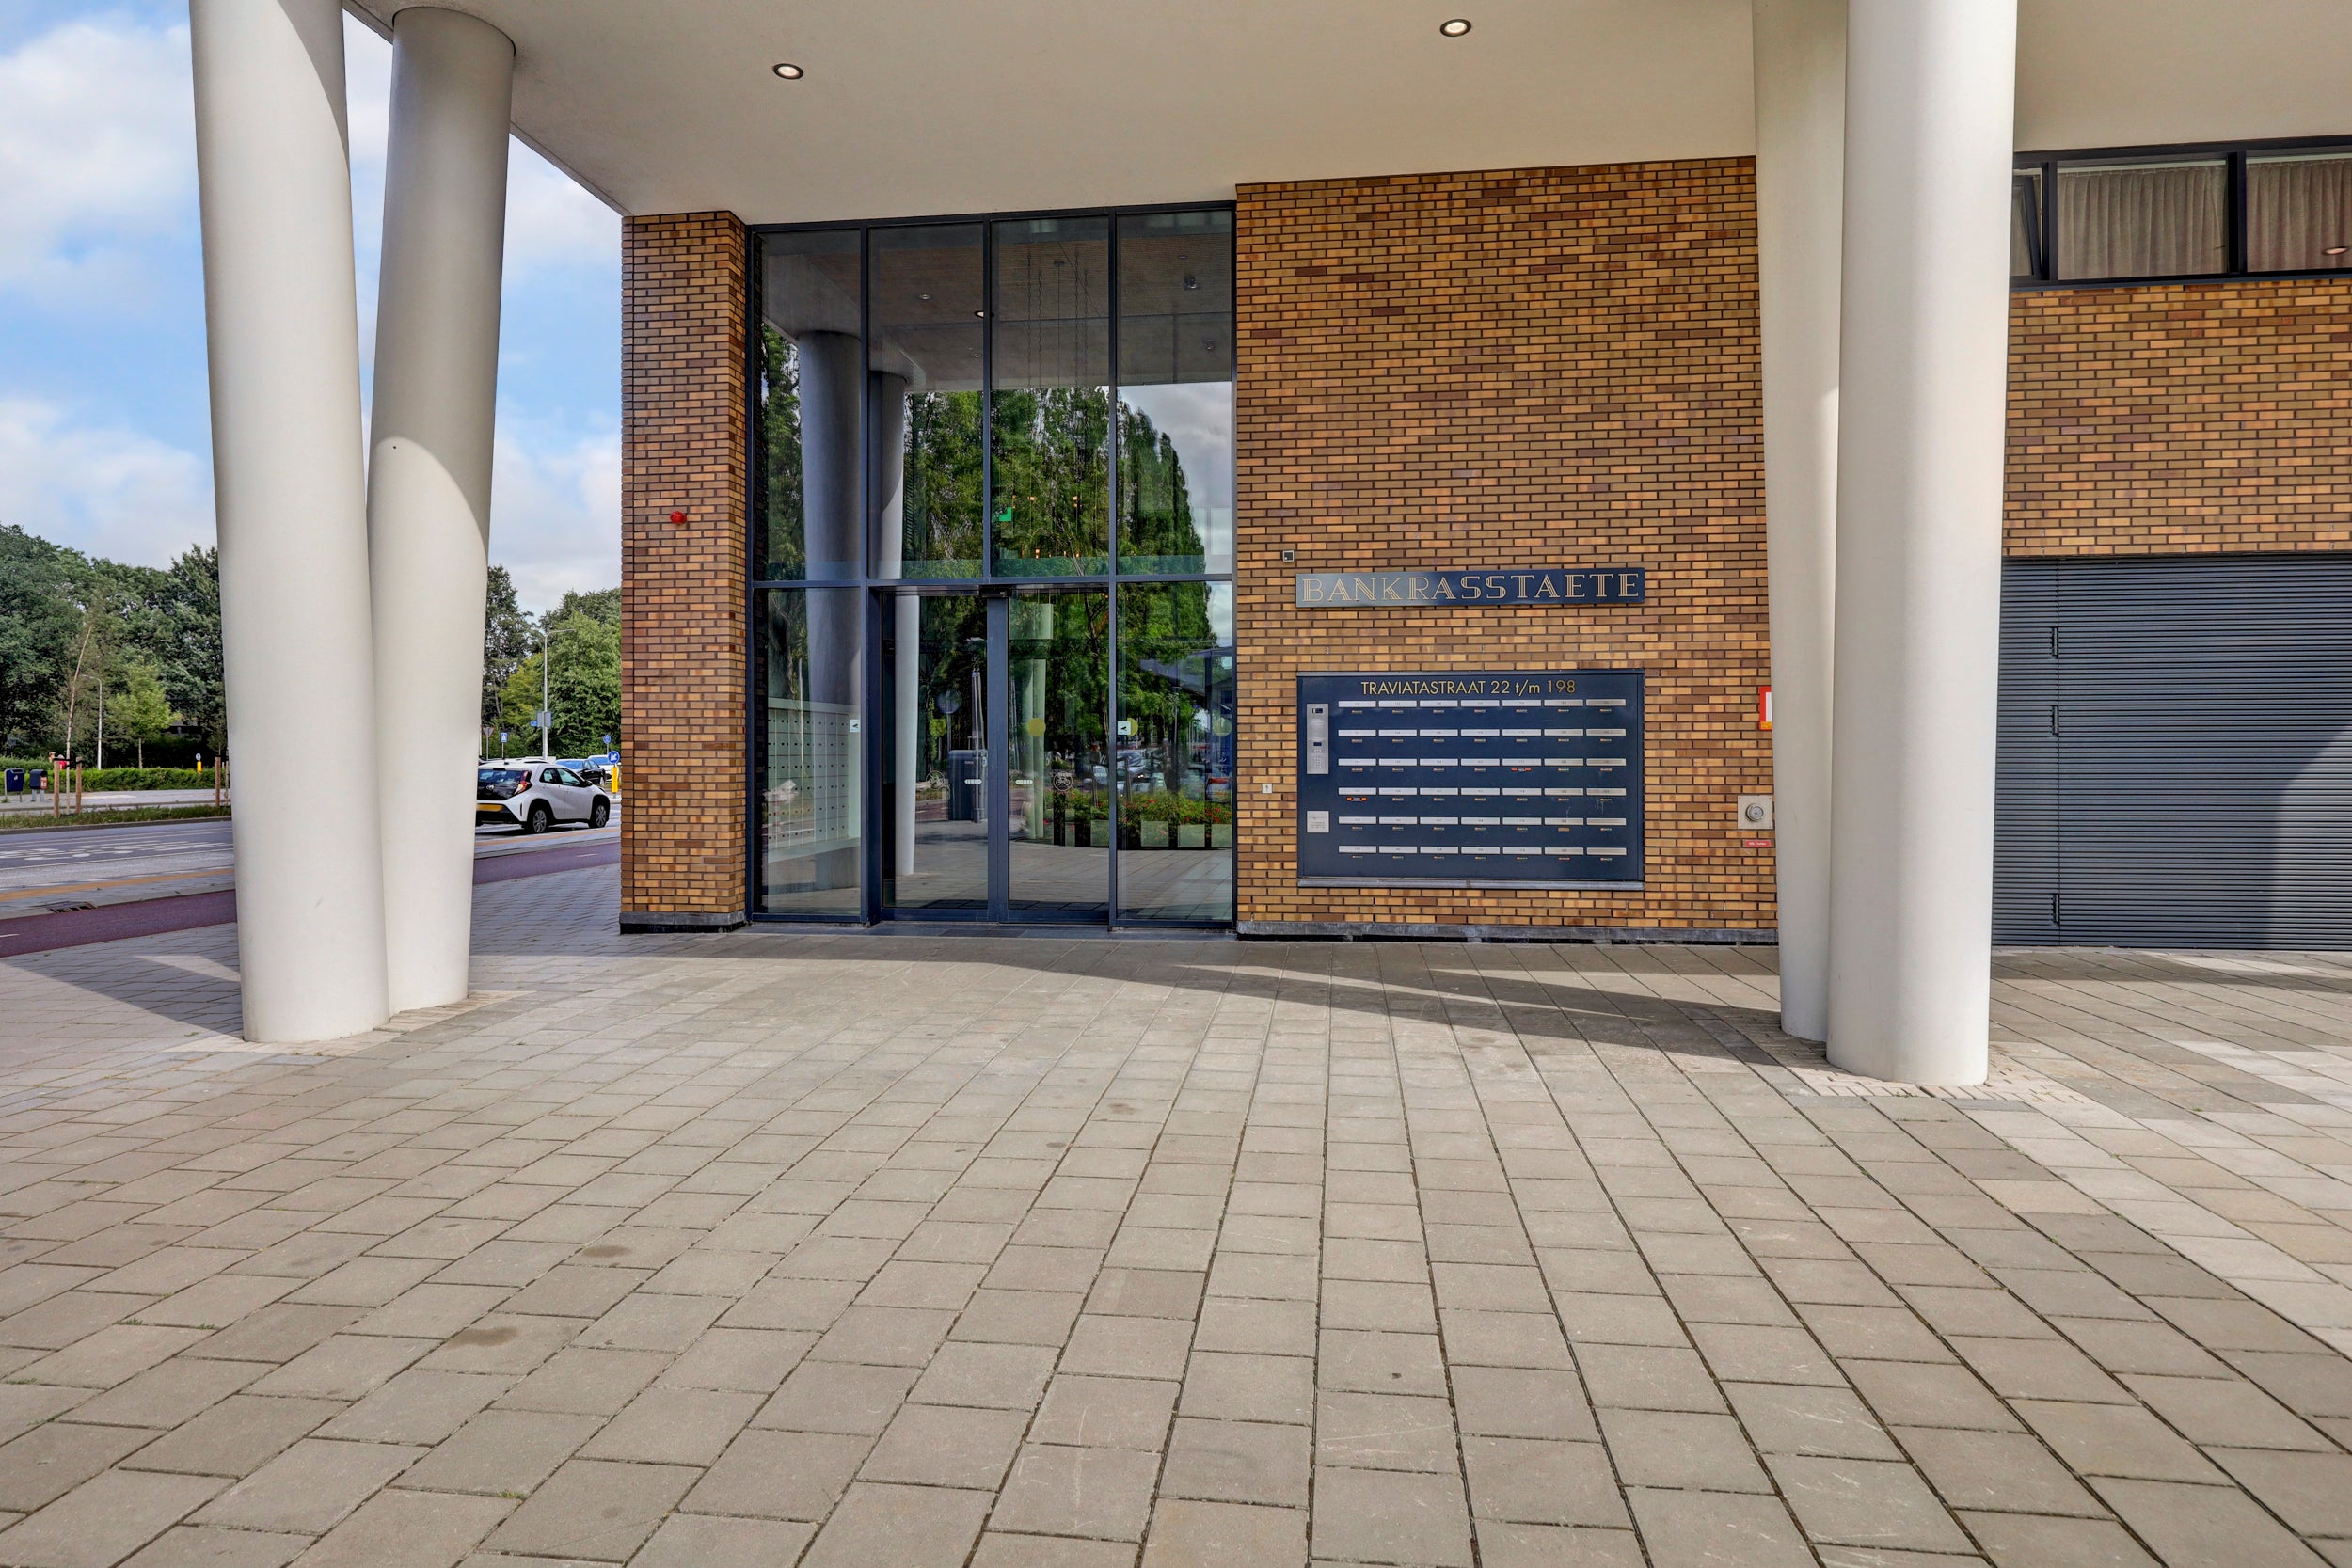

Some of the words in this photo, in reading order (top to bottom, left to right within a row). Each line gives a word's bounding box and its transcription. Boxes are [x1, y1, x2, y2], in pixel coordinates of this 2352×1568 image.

[1301, 573, 1639, 602] BANKRASSTAETE
[1360, 680, 1486, 695] TRAVIATASTRAAT
[1490, 680, 1510, 694] 22
[1515, 679, 1540, 695] t/m
[1548, 679, 1576, 693] 198
